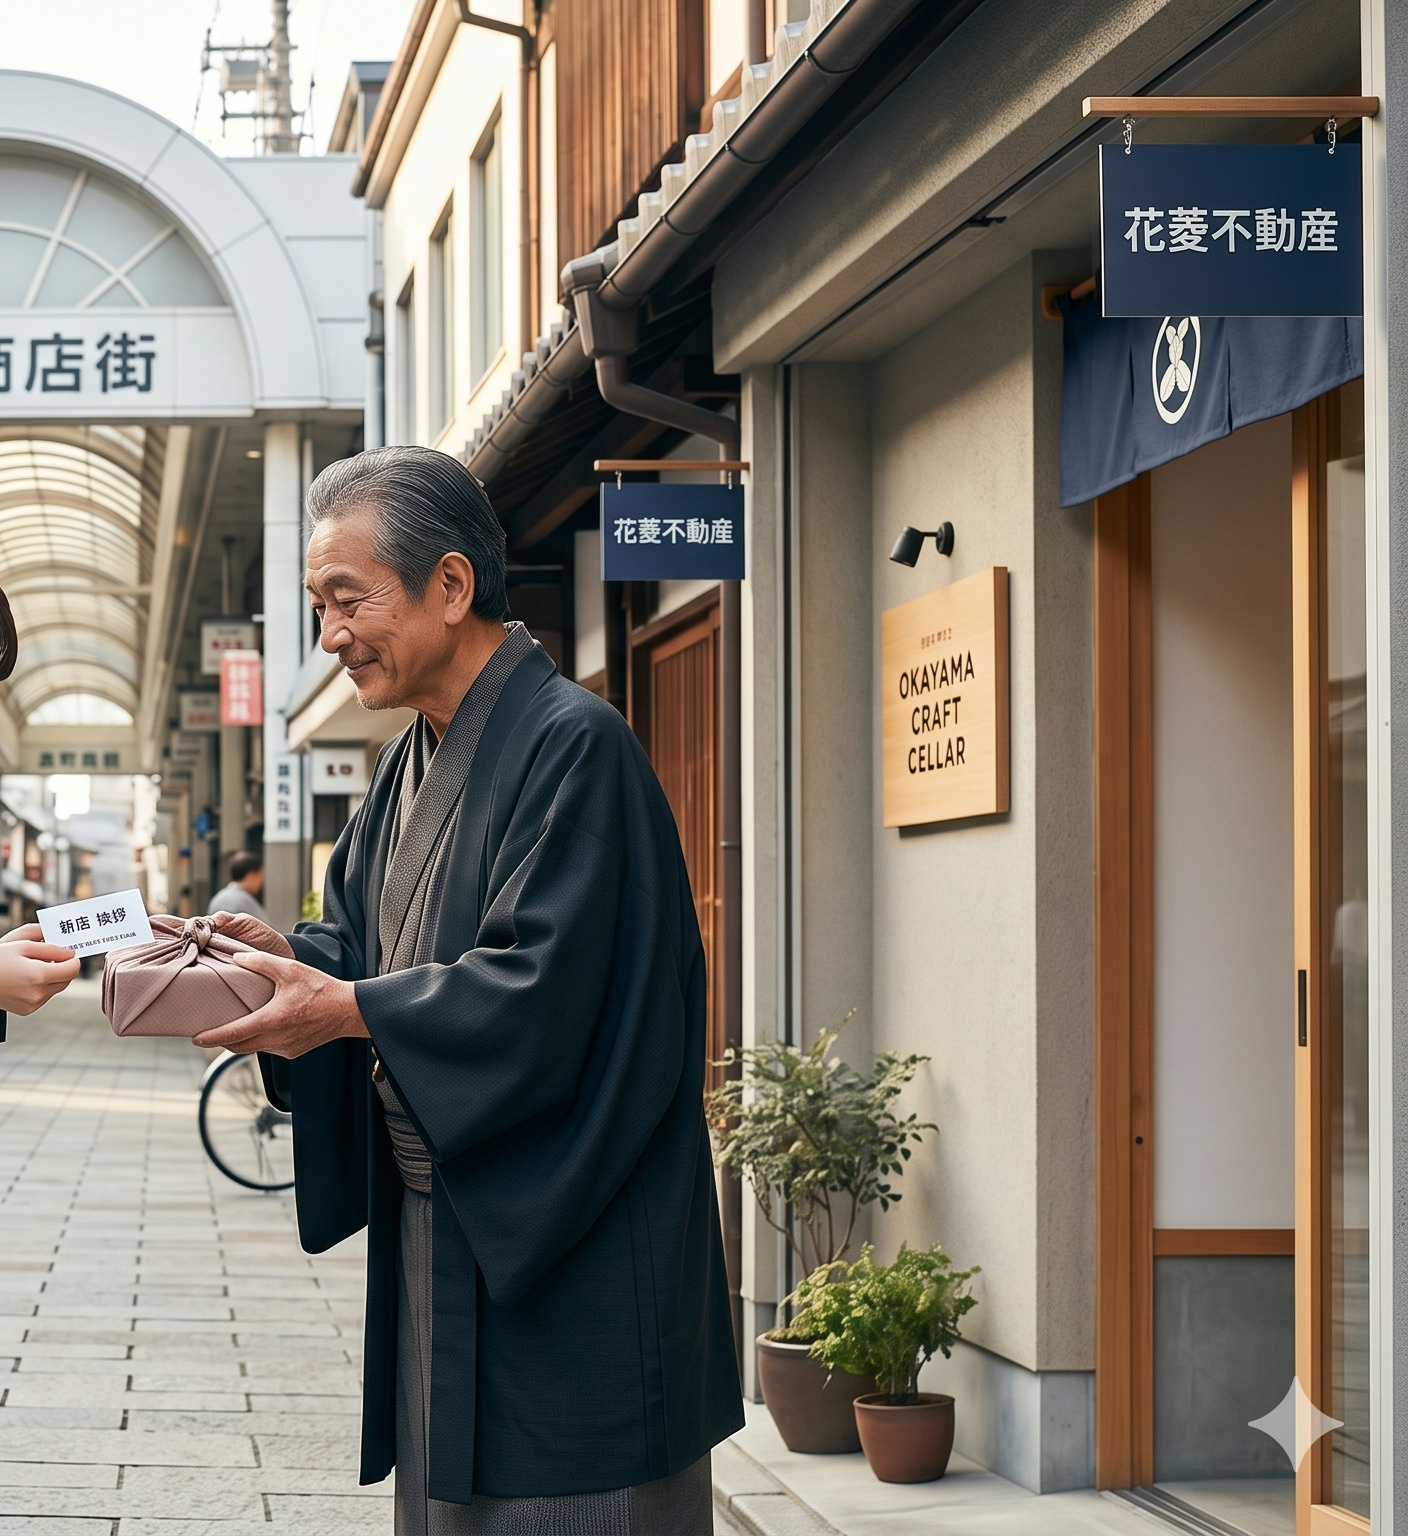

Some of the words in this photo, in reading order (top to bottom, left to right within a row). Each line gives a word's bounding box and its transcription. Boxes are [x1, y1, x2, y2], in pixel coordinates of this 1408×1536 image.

[1123, 206, 1339, 253] 花菱不動産
[613, 517, 734, 545] 花菱不動産
[899, 651, 975, 700] OKAYAMA
[911, 696, 961, 736] CRAFT
[908, 736, 966, 775] CELLAR
